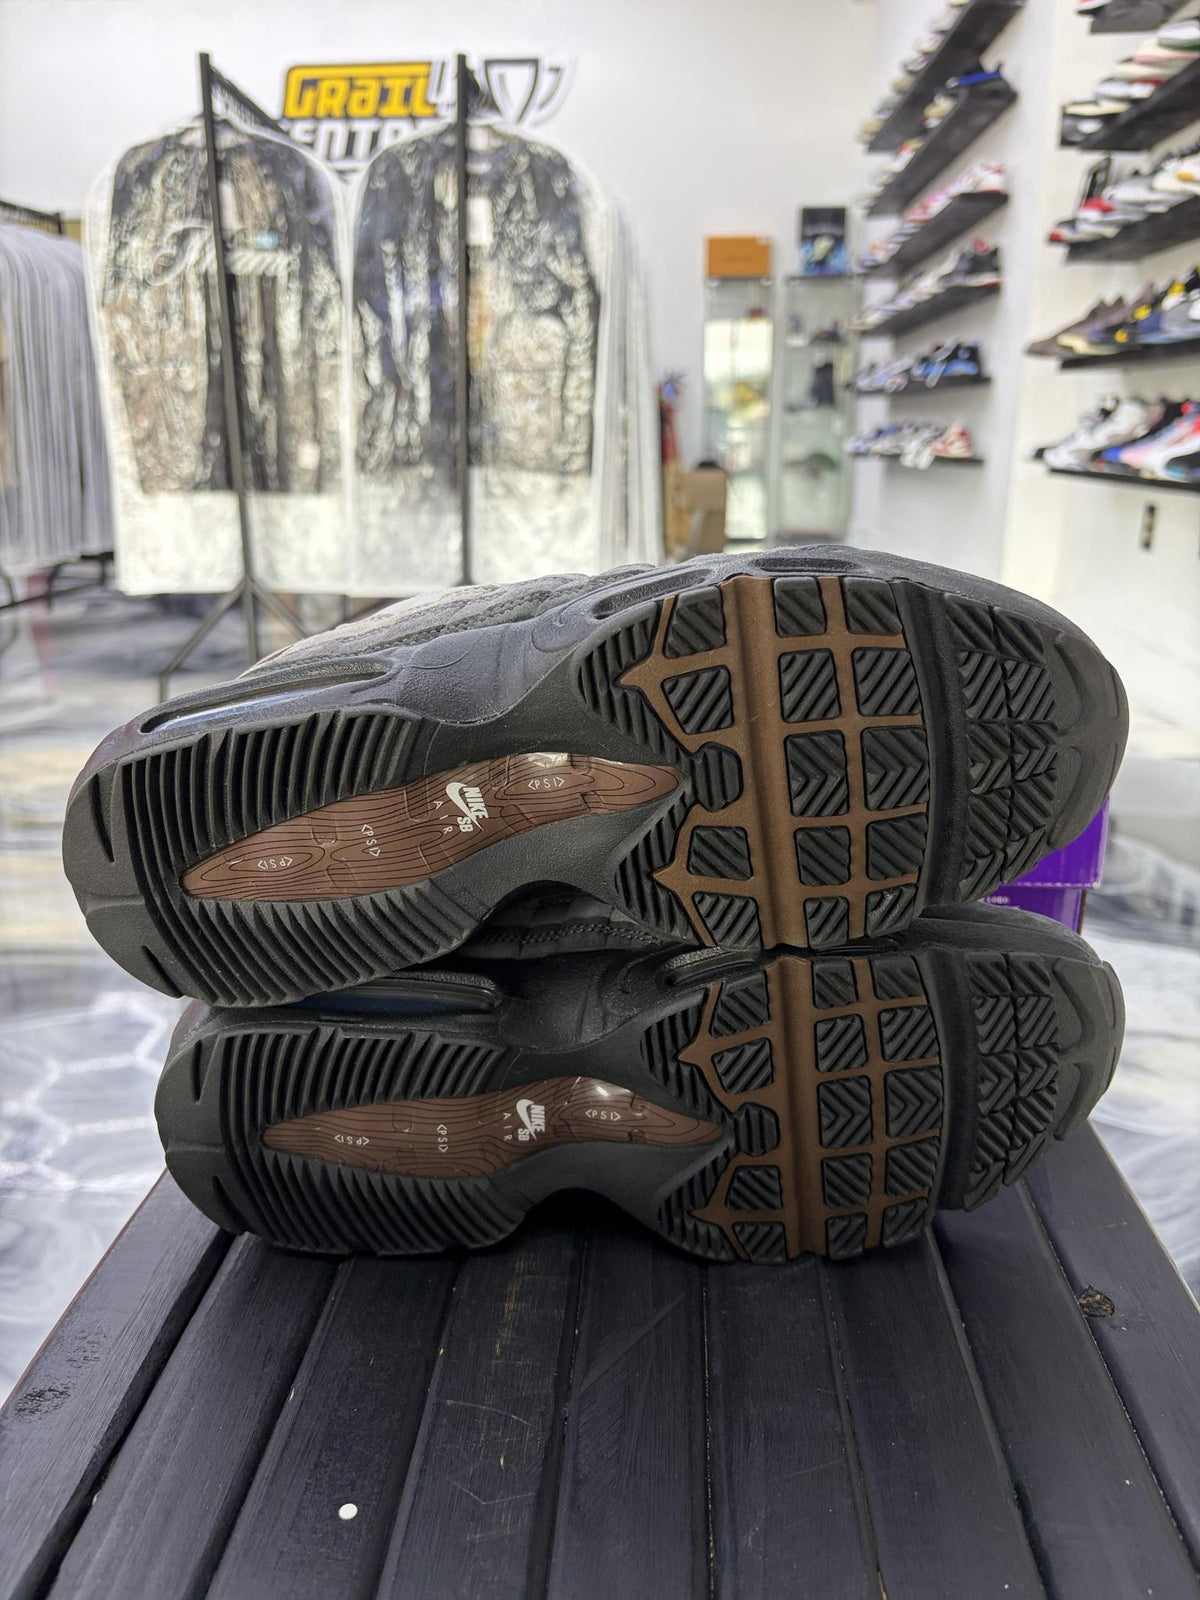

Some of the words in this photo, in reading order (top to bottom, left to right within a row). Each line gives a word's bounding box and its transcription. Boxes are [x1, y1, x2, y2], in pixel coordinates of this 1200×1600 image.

[433, 800, 453, 835] AIR
[462, 787, 489, 819] NIKE
[457, 816, 474, 833] SB
[530, 1104, 546, 1133] NIKE
[517, 1128, 530, 1142] SB
